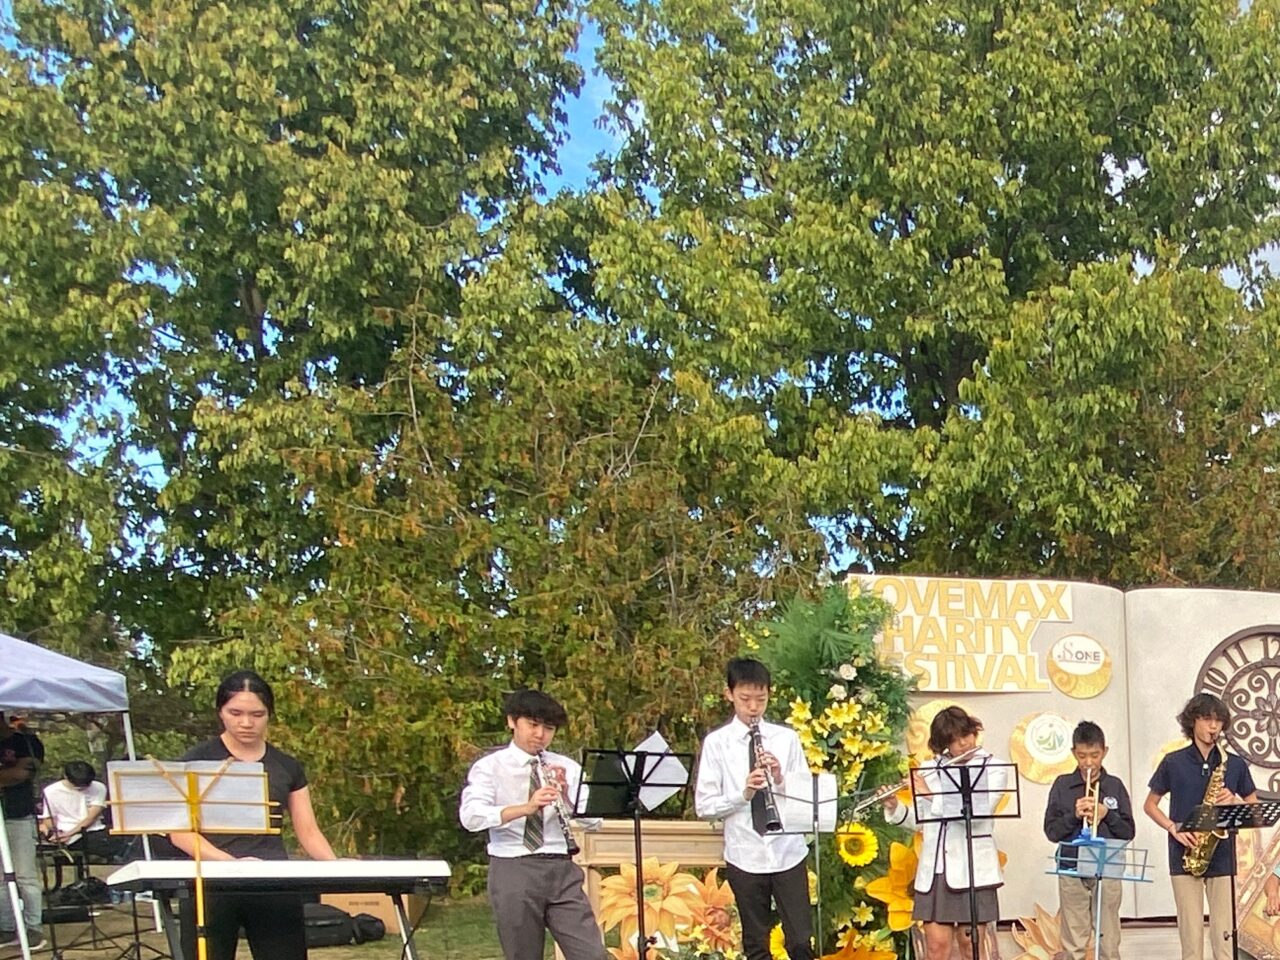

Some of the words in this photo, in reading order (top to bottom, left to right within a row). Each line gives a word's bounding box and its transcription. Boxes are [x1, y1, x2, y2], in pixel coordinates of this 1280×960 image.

[851, 577, 1069, 620] OVEMAX
[1222, 641, 1251, 672] 11
[1201, 667, 1228, 697] 10
